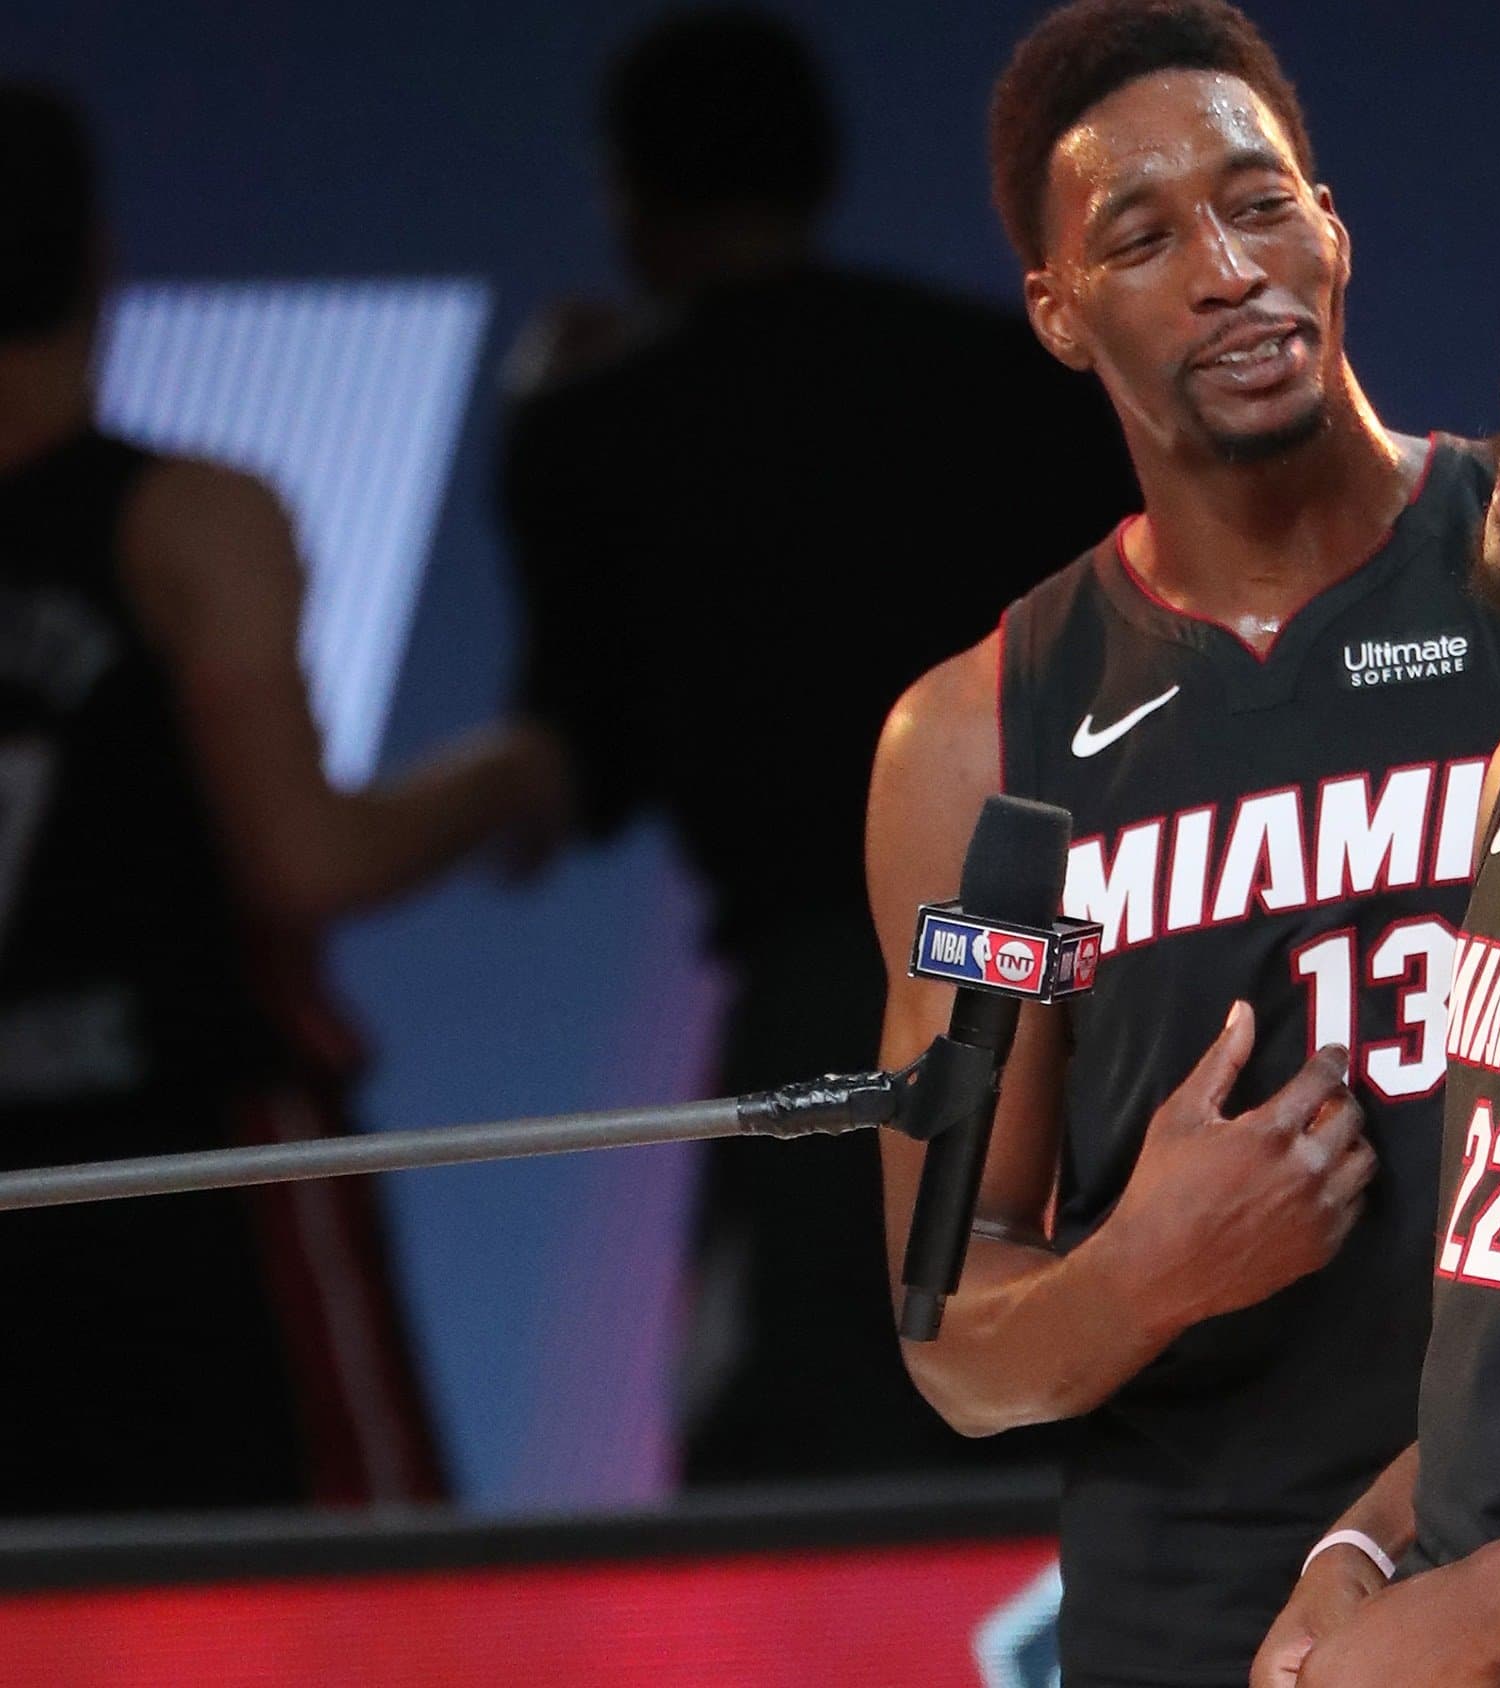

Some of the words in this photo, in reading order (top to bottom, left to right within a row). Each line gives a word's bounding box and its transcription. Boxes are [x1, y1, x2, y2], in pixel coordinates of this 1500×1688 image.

[1344, 635, 1468, 671] Ultimate
[1351, 658, 1464, 687] SOFTWARE
[1063, 757, 1490, 960] MIAMI
[931, 930, 966, 966] NBA
[998, 952, 1034, 973] TNT
[1291, 914, 1461, 1102] 13
